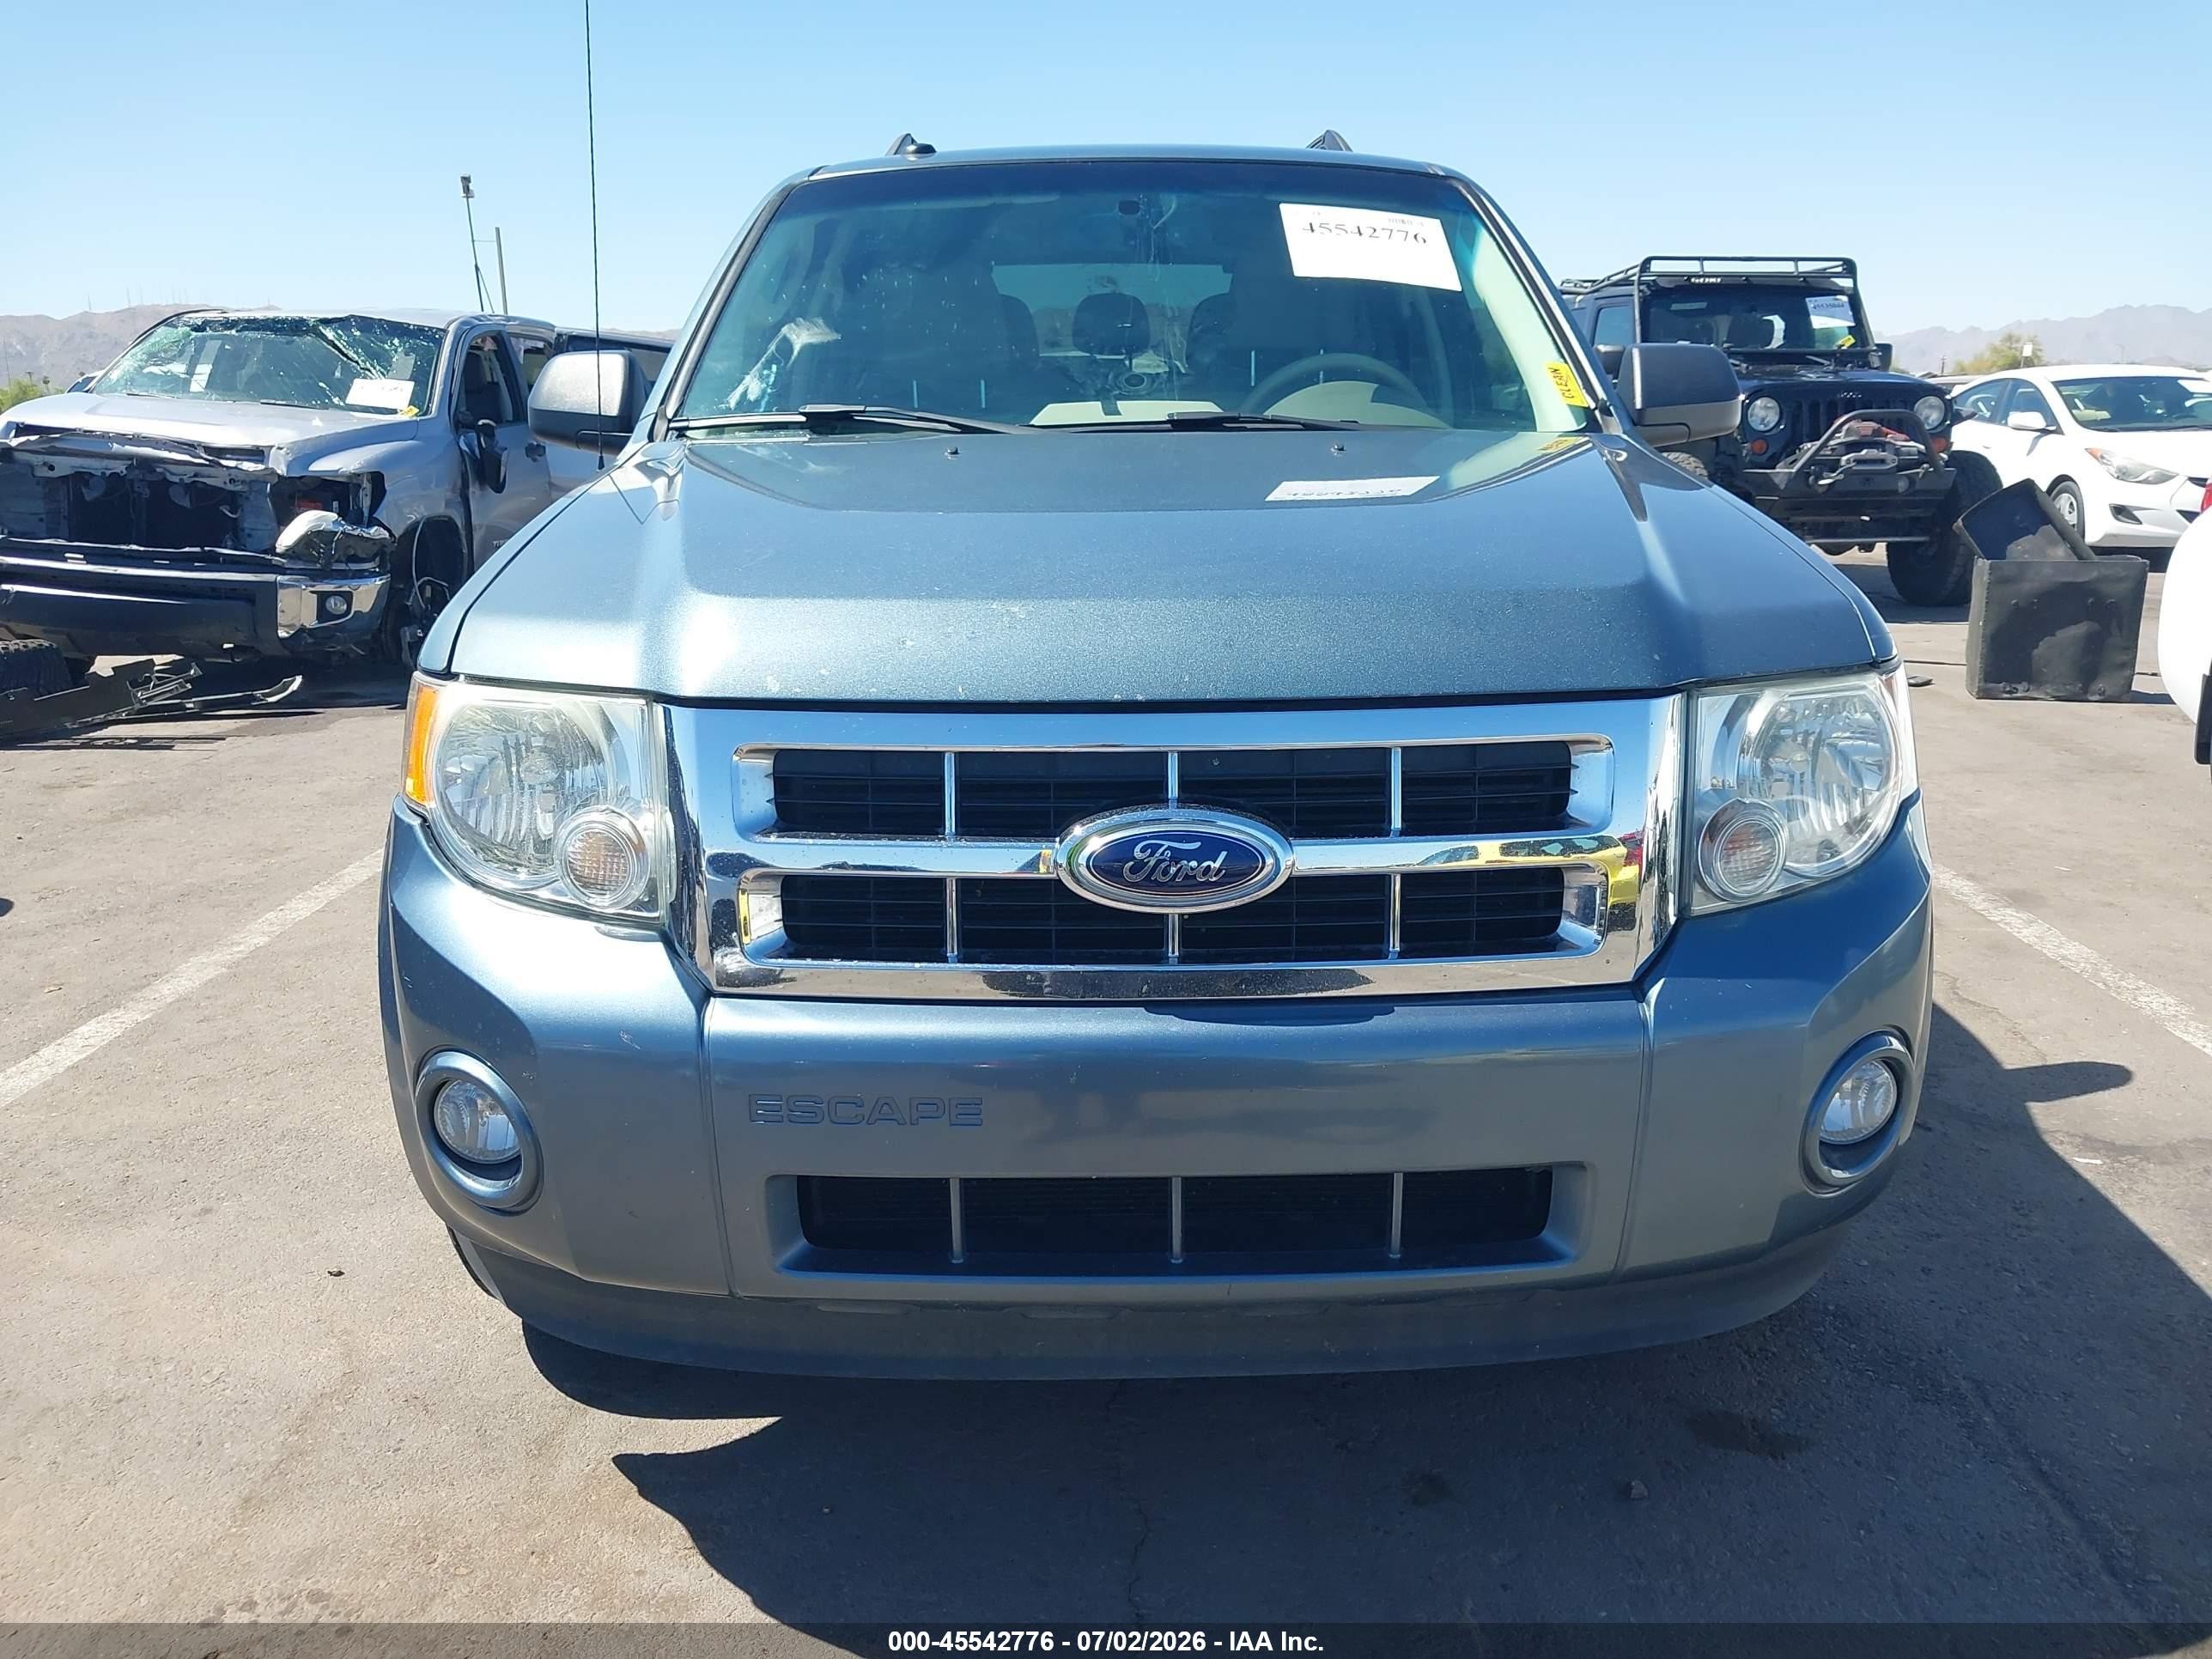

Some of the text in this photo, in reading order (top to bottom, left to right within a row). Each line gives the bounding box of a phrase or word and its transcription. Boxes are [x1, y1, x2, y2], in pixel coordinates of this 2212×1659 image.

[1302, 222, 1429, 246] 45542776
[1547, 367, 1575, 399] CLEAN
[1121, 839, 1229, 884] Ford
[747, 1093, 984, 1127] ESCAPE
